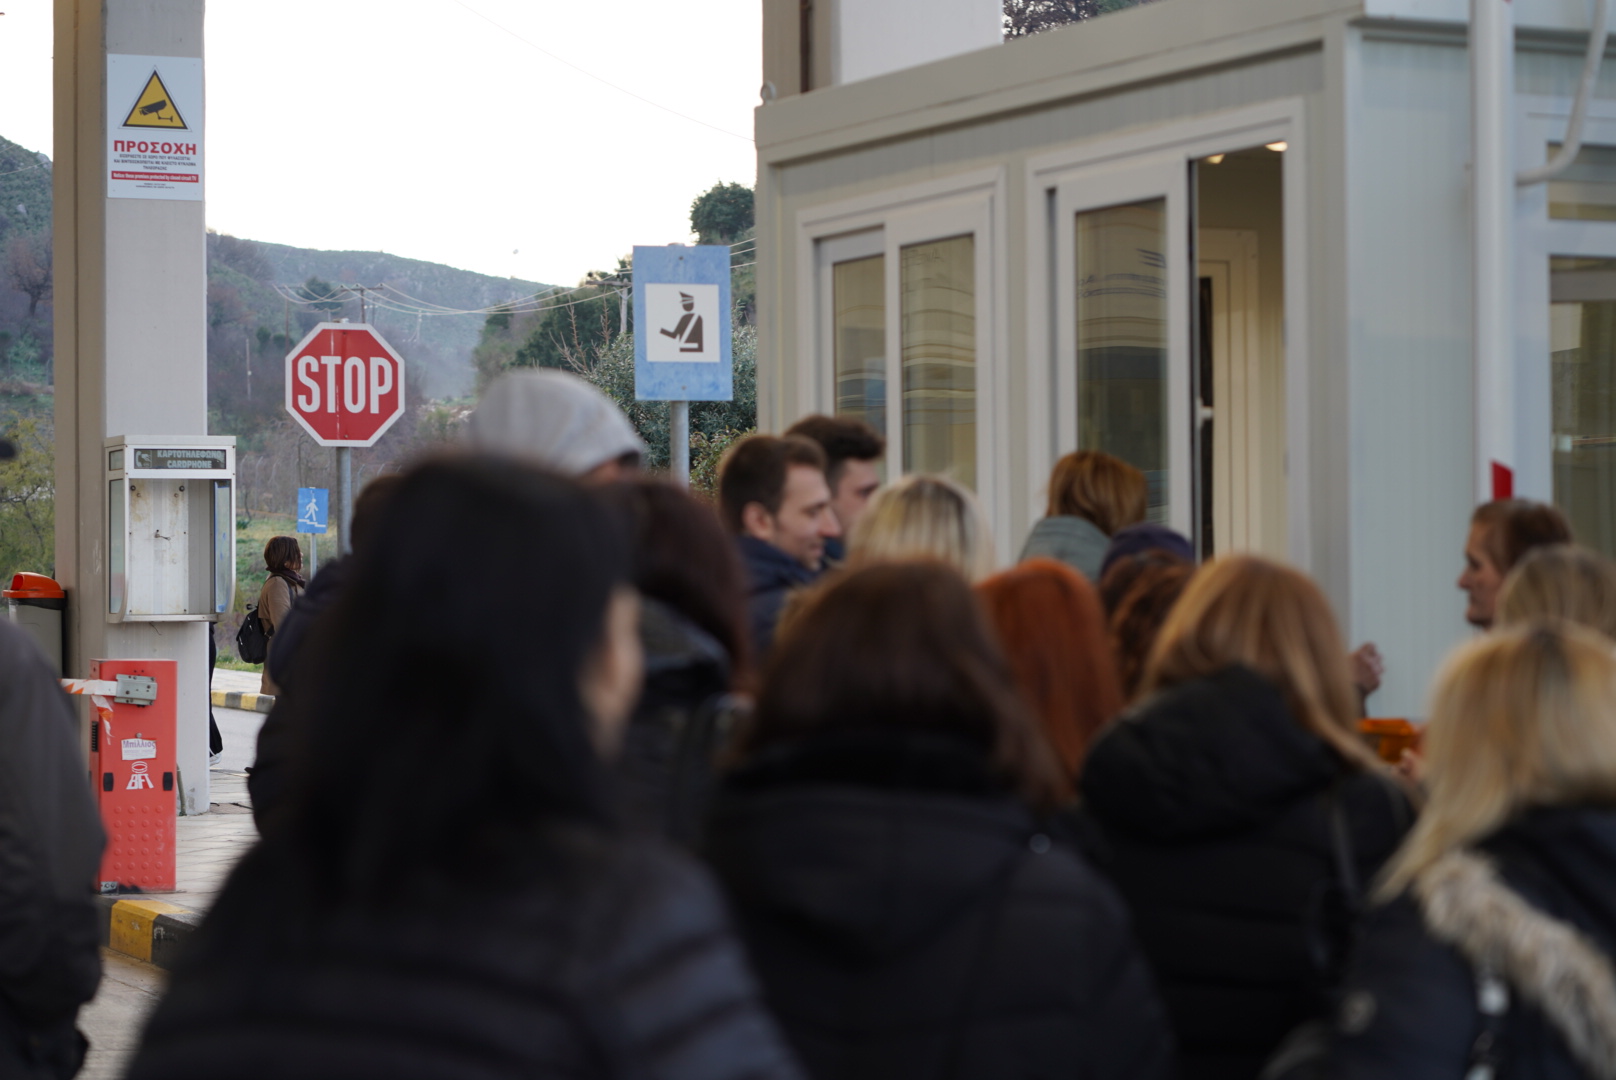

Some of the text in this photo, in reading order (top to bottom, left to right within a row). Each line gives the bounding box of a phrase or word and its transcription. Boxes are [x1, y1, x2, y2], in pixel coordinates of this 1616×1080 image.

[114, 140, 196, 155] ΠΡΟΣΟΧΗ
[298, 355, 393, 415] STOP
[157, 450, 222, 459] ΚΑΡΤΟΤΗΛΕΦΩΝΟ
[167, 460, 212, 469] CARDPHONE
